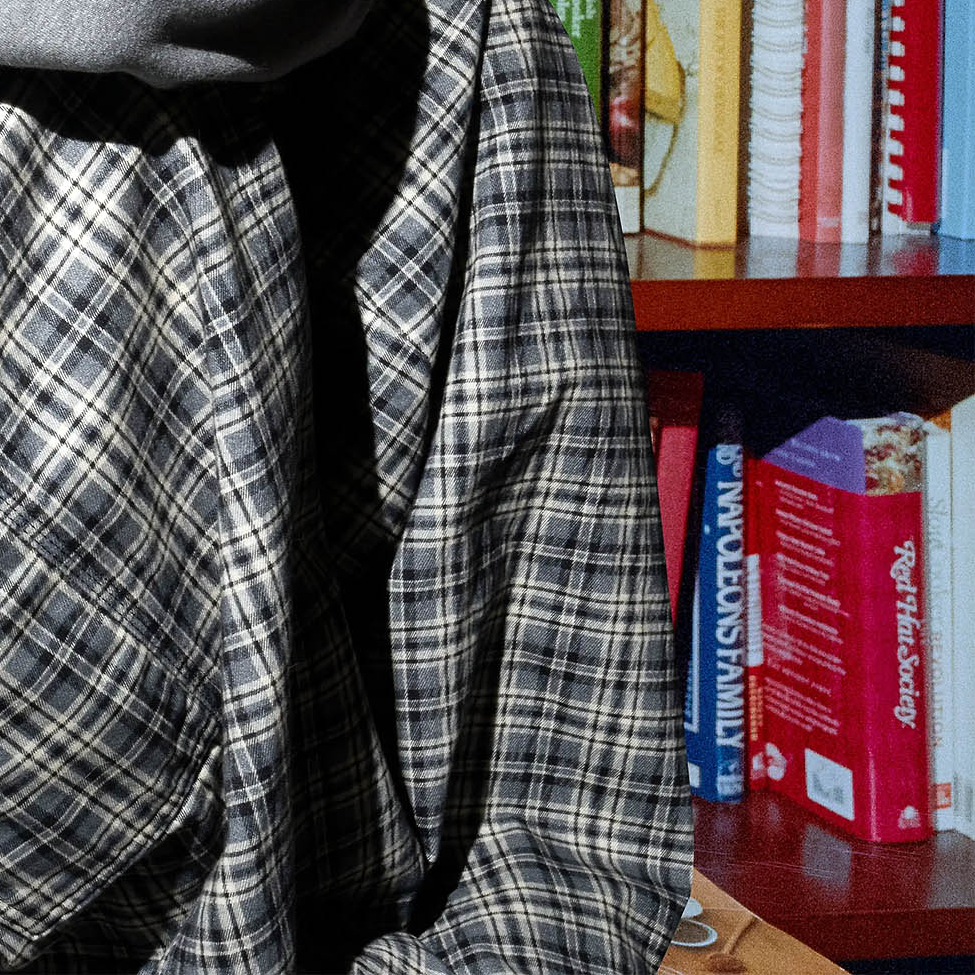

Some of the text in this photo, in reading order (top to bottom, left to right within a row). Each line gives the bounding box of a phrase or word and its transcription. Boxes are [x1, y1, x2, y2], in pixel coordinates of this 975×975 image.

[715, 645, 744, 746] FAMILY
[890, 539, 921, 729] Red Hat Society
